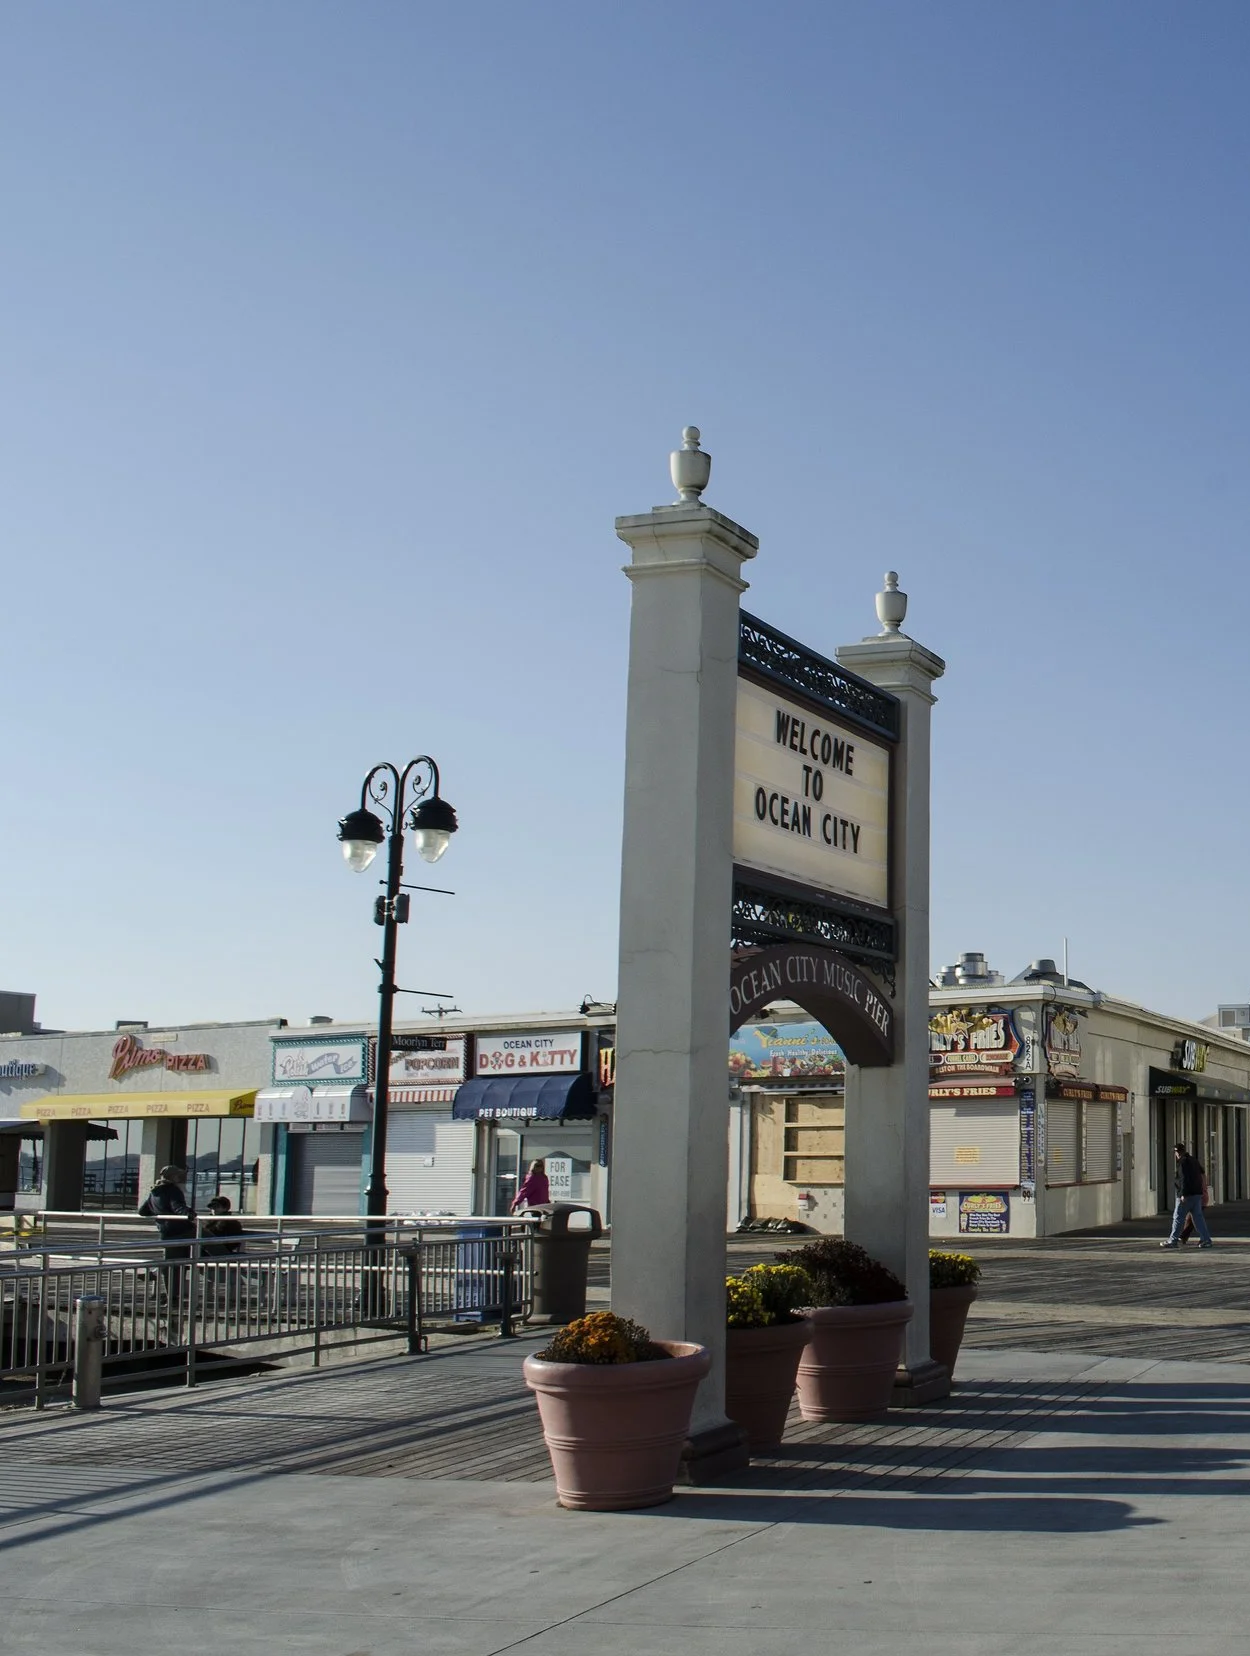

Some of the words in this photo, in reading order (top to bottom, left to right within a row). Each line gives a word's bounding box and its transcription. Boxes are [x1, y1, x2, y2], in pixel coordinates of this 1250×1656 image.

[776, 709, 855, 776] WELCOME
[802, 764, 824, 801] TO
[755, 786, 812, 838] OCEAN
[822, 813, 861, 854] CITY
[730, 959, 782, 1015] OCEAN
[786, 956, 818, 983] CITY
[823, 959, 863, 1004] MUSIC
[864, 988, 890, 1038] PIER
[392, 1034, 428, 1048] Moorlyn
[430, 1037, 445, 1049] Terr
[969, 1019, 1006, 1050] FRIES
[503, 1040, 533, 1050] OCEAN
[534, 1039, 555, 1048] CITY
[165, 1055, 207, 1071] PIZZA
[405, 1056, 460, 1071] POPCORN
[479, 1051, 515, 1070] DOG
[518, 1054, 527, 1067] &
[963, 1087, 997, 1096] FRIES
[1155, 1085, 1191, 1094] SUBWAY
[36, 1108, 56, 1117] PIZZA
[71, 1107, 92, 1116] PIZZA
[107, 1105, 129, 1114] PIZZA
[146, 1104, 169, 1113] PIZZA
[186, 1103, 210, 1113] PIZZA
[479, 1108, 494, 1117] PET
[495, 1107, 537, 1117] BOUTIQUE
[550, 1161, 566, 1173] FOR
[550, 1175, 570, 1187] EASE
